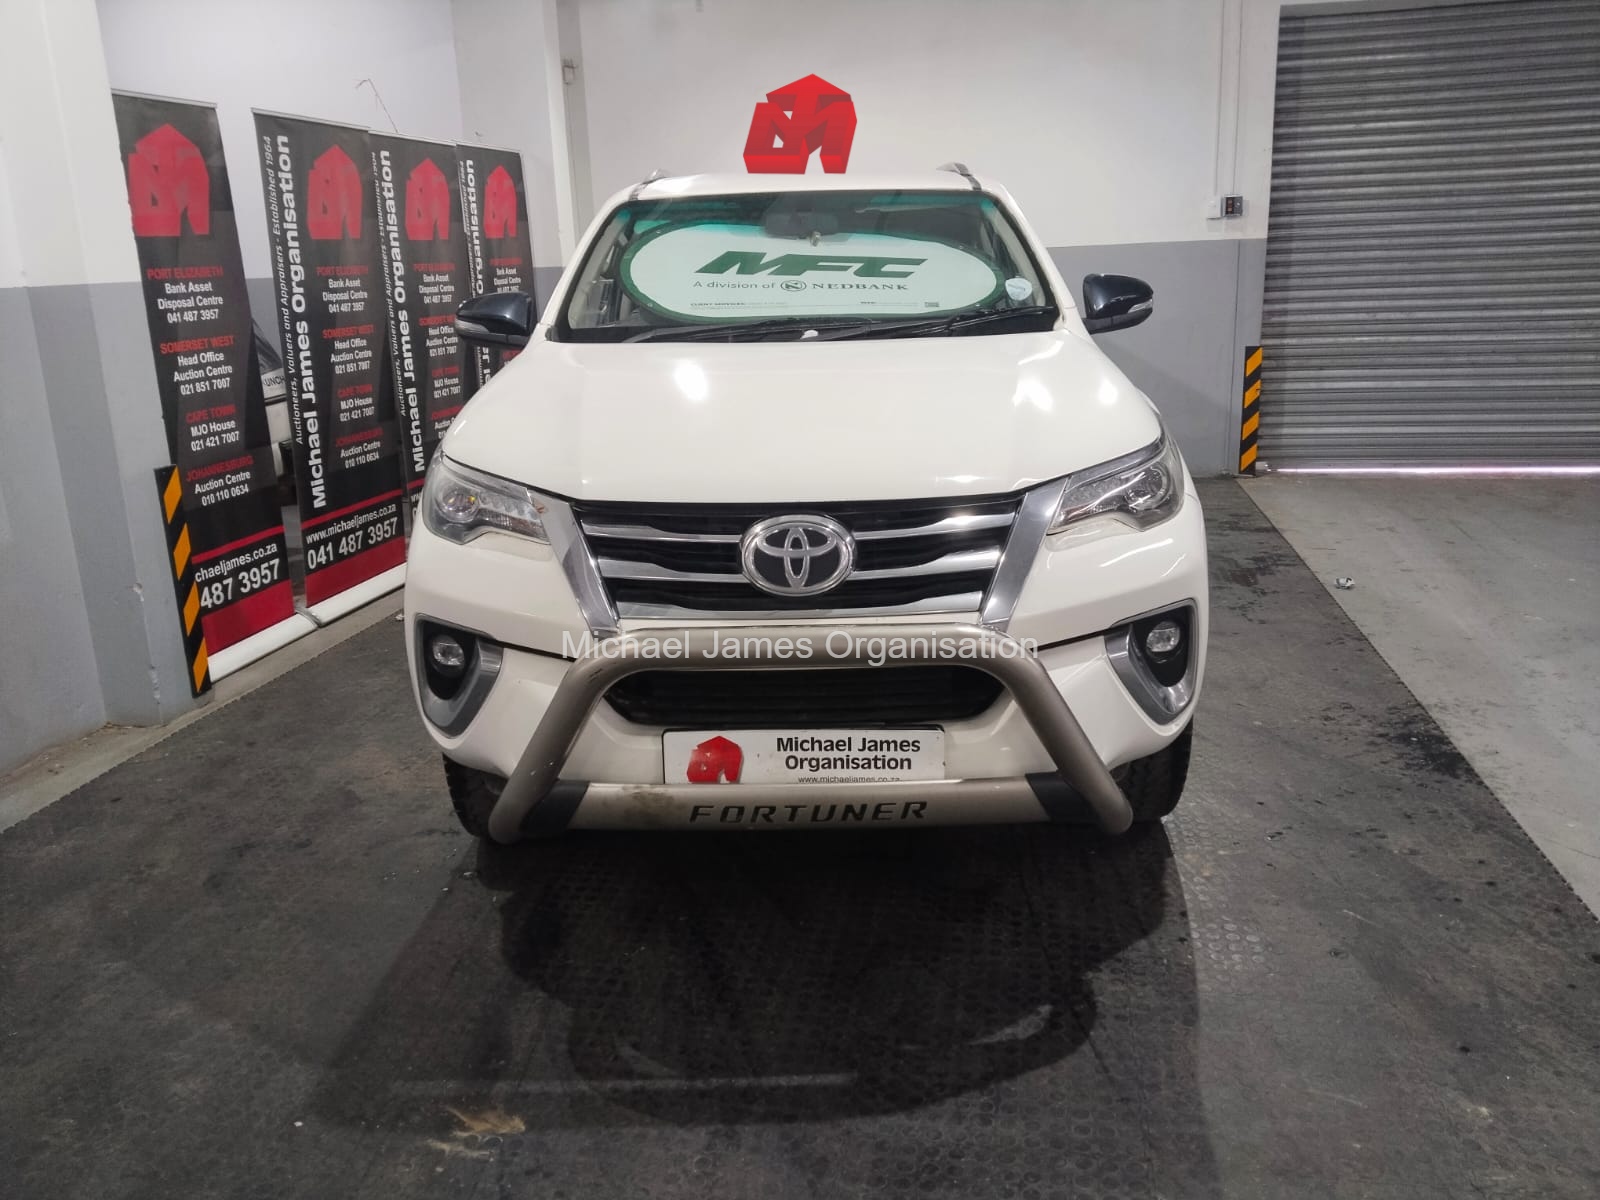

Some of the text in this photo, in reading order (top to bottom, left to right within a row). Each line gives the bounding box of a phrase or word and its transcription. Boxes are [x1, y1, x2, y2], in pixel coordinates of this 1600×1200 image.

[263, 136, 273, 165] 1964
[266, 168, 280, 235] Established
[380, 150, 406, 303] Organisation
[466, 160, 483, 294] Organisation
[694, 250, 928, 278] MFC
[276, 246, 288, 306] Appraisers
[328, 279, 344, 288] Bank
[707, 281, 758, 289] division
[165, 282, 212, 294] Bank Asset
[322, 290, 368, 302] Disposal Centre
[157, 296, 223, 310] Disposal Centre
[167, 309, 219, 323] 041 487 3957
[277, 136, 326, 508] Michael James Organisation
[281, 308, 291, 330] and
[160, 335, 234, 354] SOMERSET WEST
[286, 333, 296, 374] Valuers
[335, 338, 367, 350] Head Office
[398, 310, 415, 381] James
[178, 352, 224, 366] Head Office
[330, 350, 372, 363] Auction Centre
[174, 365, 232, 382] Auction Centre
[180, 378, 231, 395] 021 851 7007
[340, 397, 372, 409] MJO House
[351, 409, 361, 419] 421
[190, 419, 236, 437] MJO House
[406, 388, 425, 472] Michael
[191, 431, 240, 452] 021 421 7007
[340, 441, 381, 458] Auction Centre
[195, 470, 250, 494] Auction Centre
[202, 484, 249, 506] 010 110 0634
[306, 504, 396, 544] www.michaeljames.co.za
[308, 517, 398, 569] 041 487 3957
[195, 543, 278, 582] chaeljames.co.za
[200, 558, 279, 608] 487 3957
[777, 737, 920, 752] Michael James
[785, 755, 912, 772] Organisation
[689, 801, 927, 823] FORTUNER
